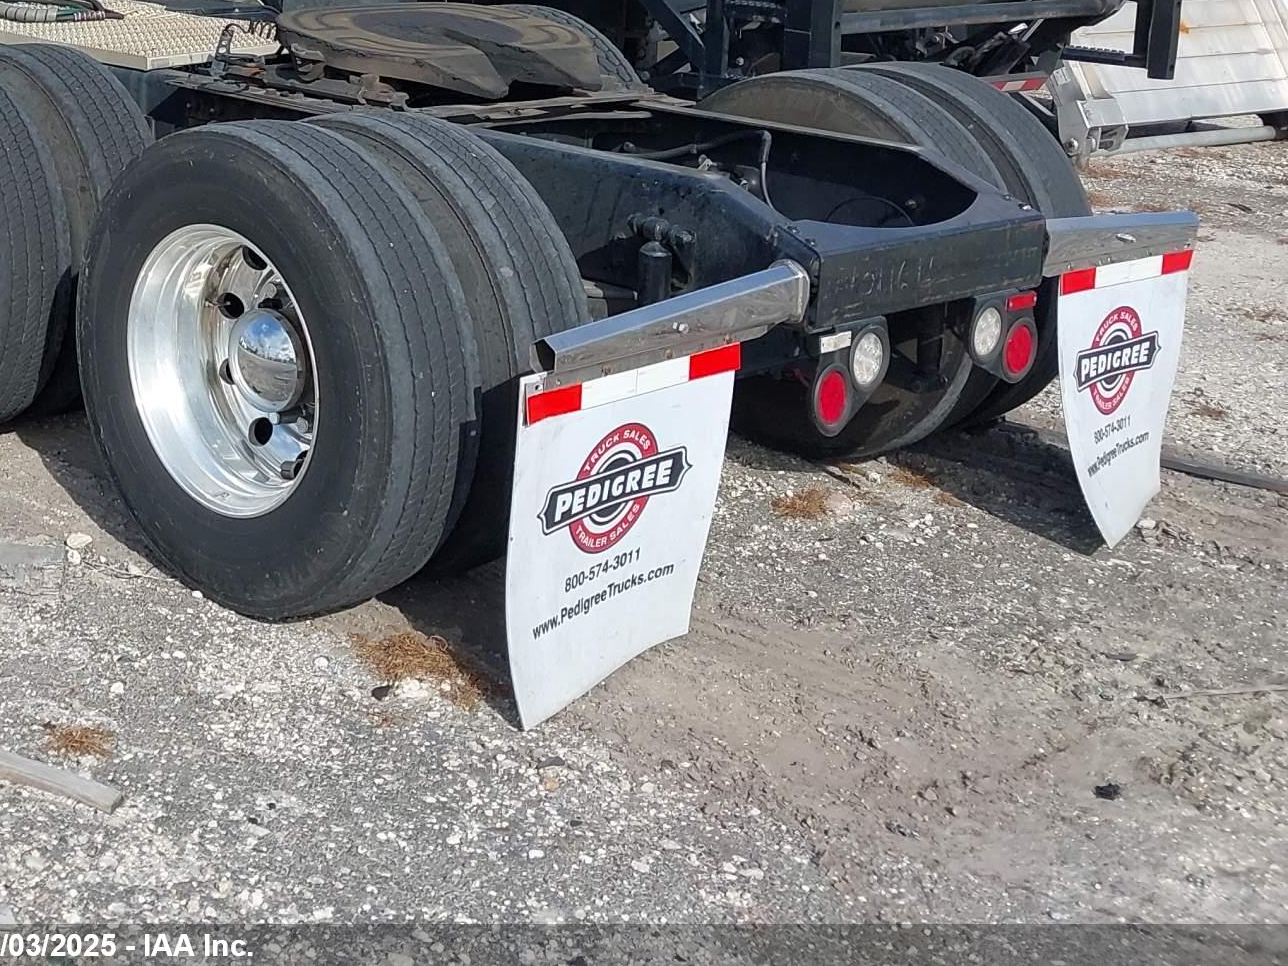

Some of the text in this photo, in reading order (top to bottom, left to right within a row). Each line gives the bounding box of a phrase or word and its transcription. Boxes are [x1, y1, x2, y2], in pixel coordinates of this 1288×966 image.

[1095, 311, 1138, 342] TRUCK SALES
[1081, 341, 1151, 383] PEDIGREE
[583, 429, 651, 473] TRUCK SALES
[554, 458, 674, 523] PEDIGREE
[575, 503, 641, 548] TRAILER SALES
[564, 546, 641, 593] 800-574-3011
[532, 563, 675, 641] www.PedigreeTrucks.com
